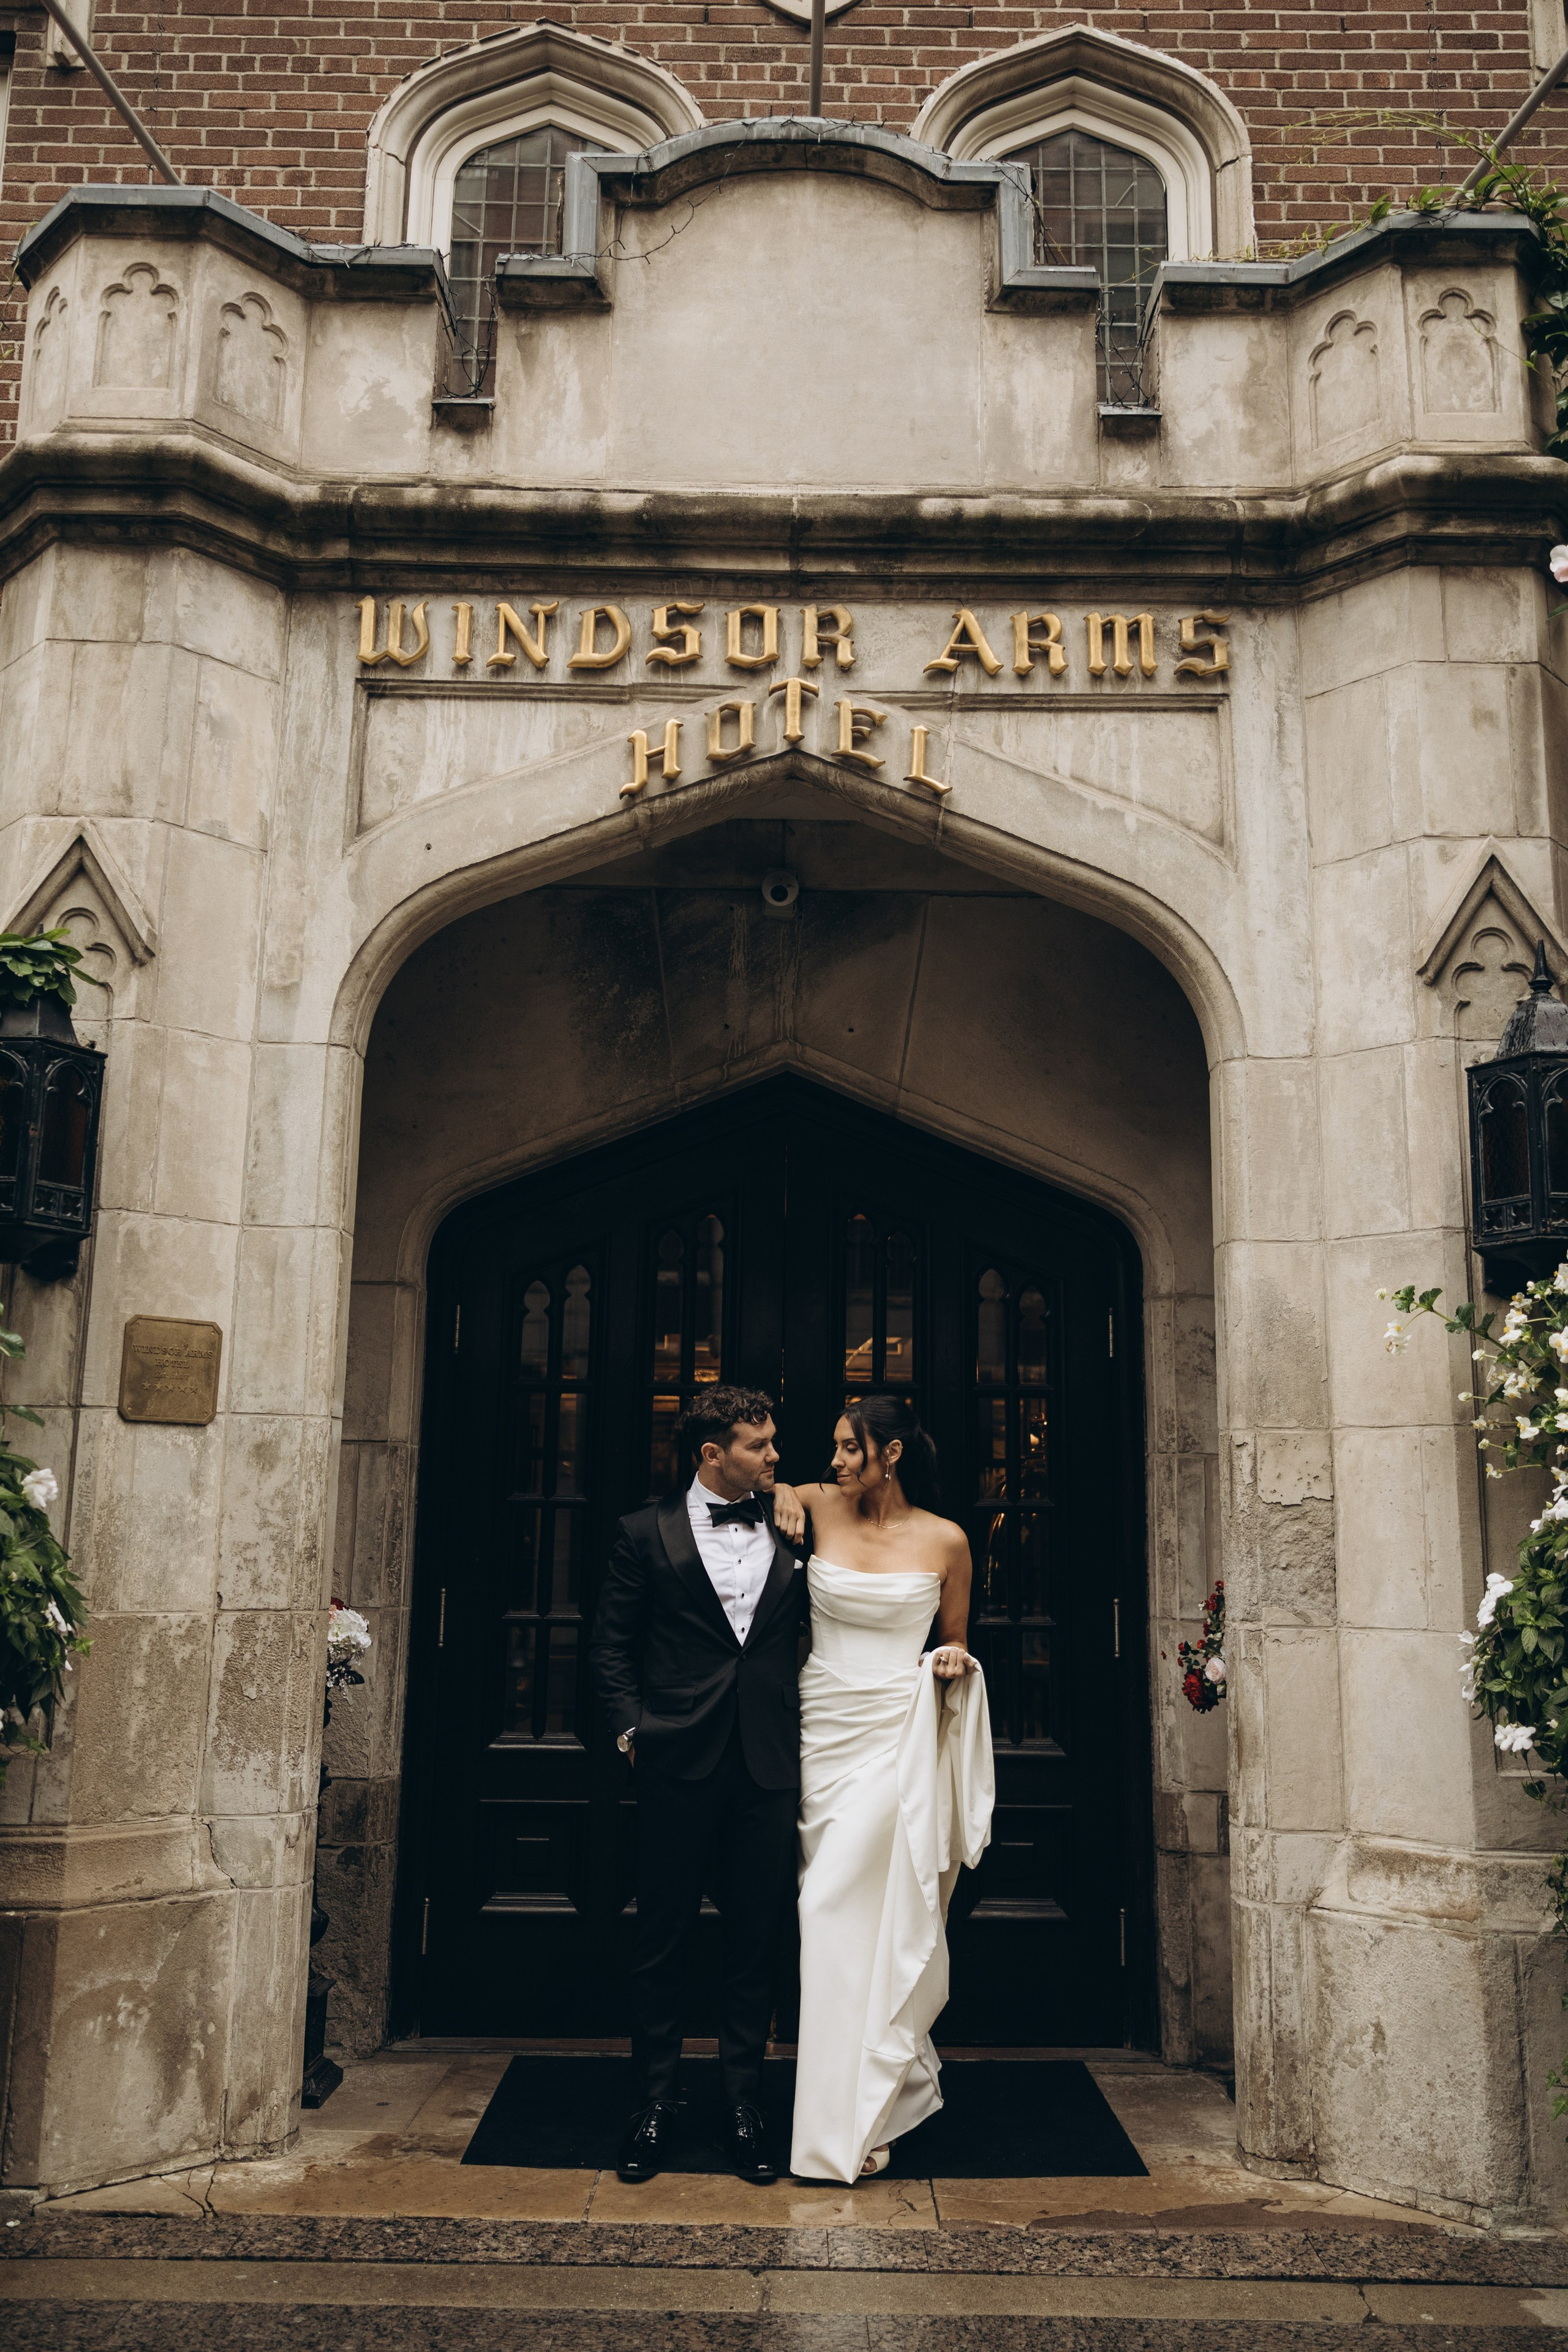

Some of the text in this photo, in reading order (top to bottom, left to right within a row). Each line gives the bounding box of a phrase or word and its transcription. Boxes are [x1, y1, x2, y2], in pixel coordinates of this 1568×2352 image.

[355, 595, 1232, 677] WINDSOR ARMS
[619, 677, 952, 799] HOTEL
[133, 1344, 213, 1359] WINDSOR ARMS
[155, 1359, 189, 1368] HOTEL
